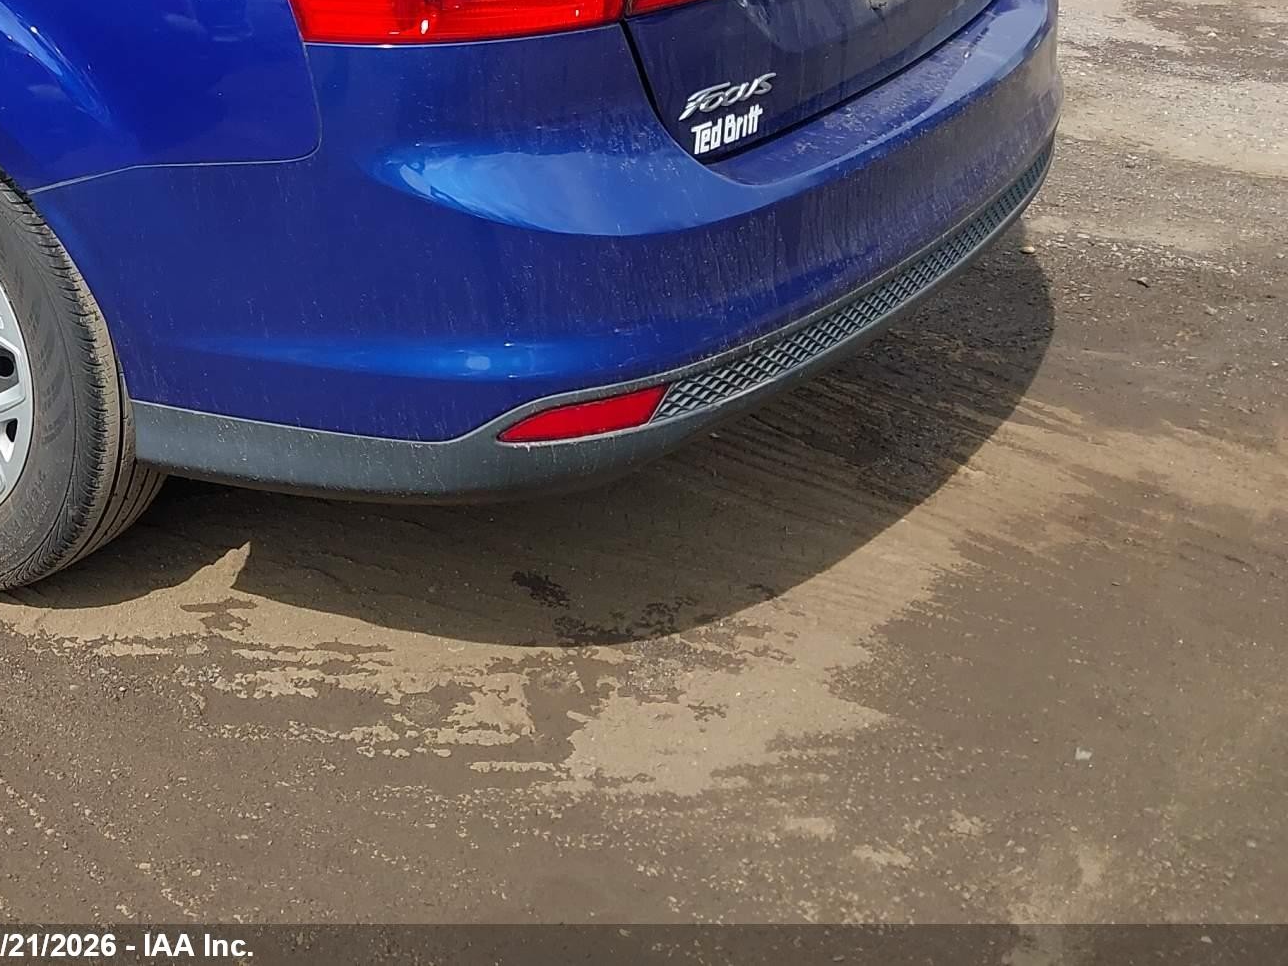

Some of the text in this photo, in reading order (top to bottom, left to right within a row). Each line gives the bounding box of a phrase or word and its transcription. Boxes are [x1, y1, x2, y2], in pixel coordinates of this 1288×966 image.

[678, 72, 777, 122] Focus
[691, 104, 764, 155] Ted Britt
